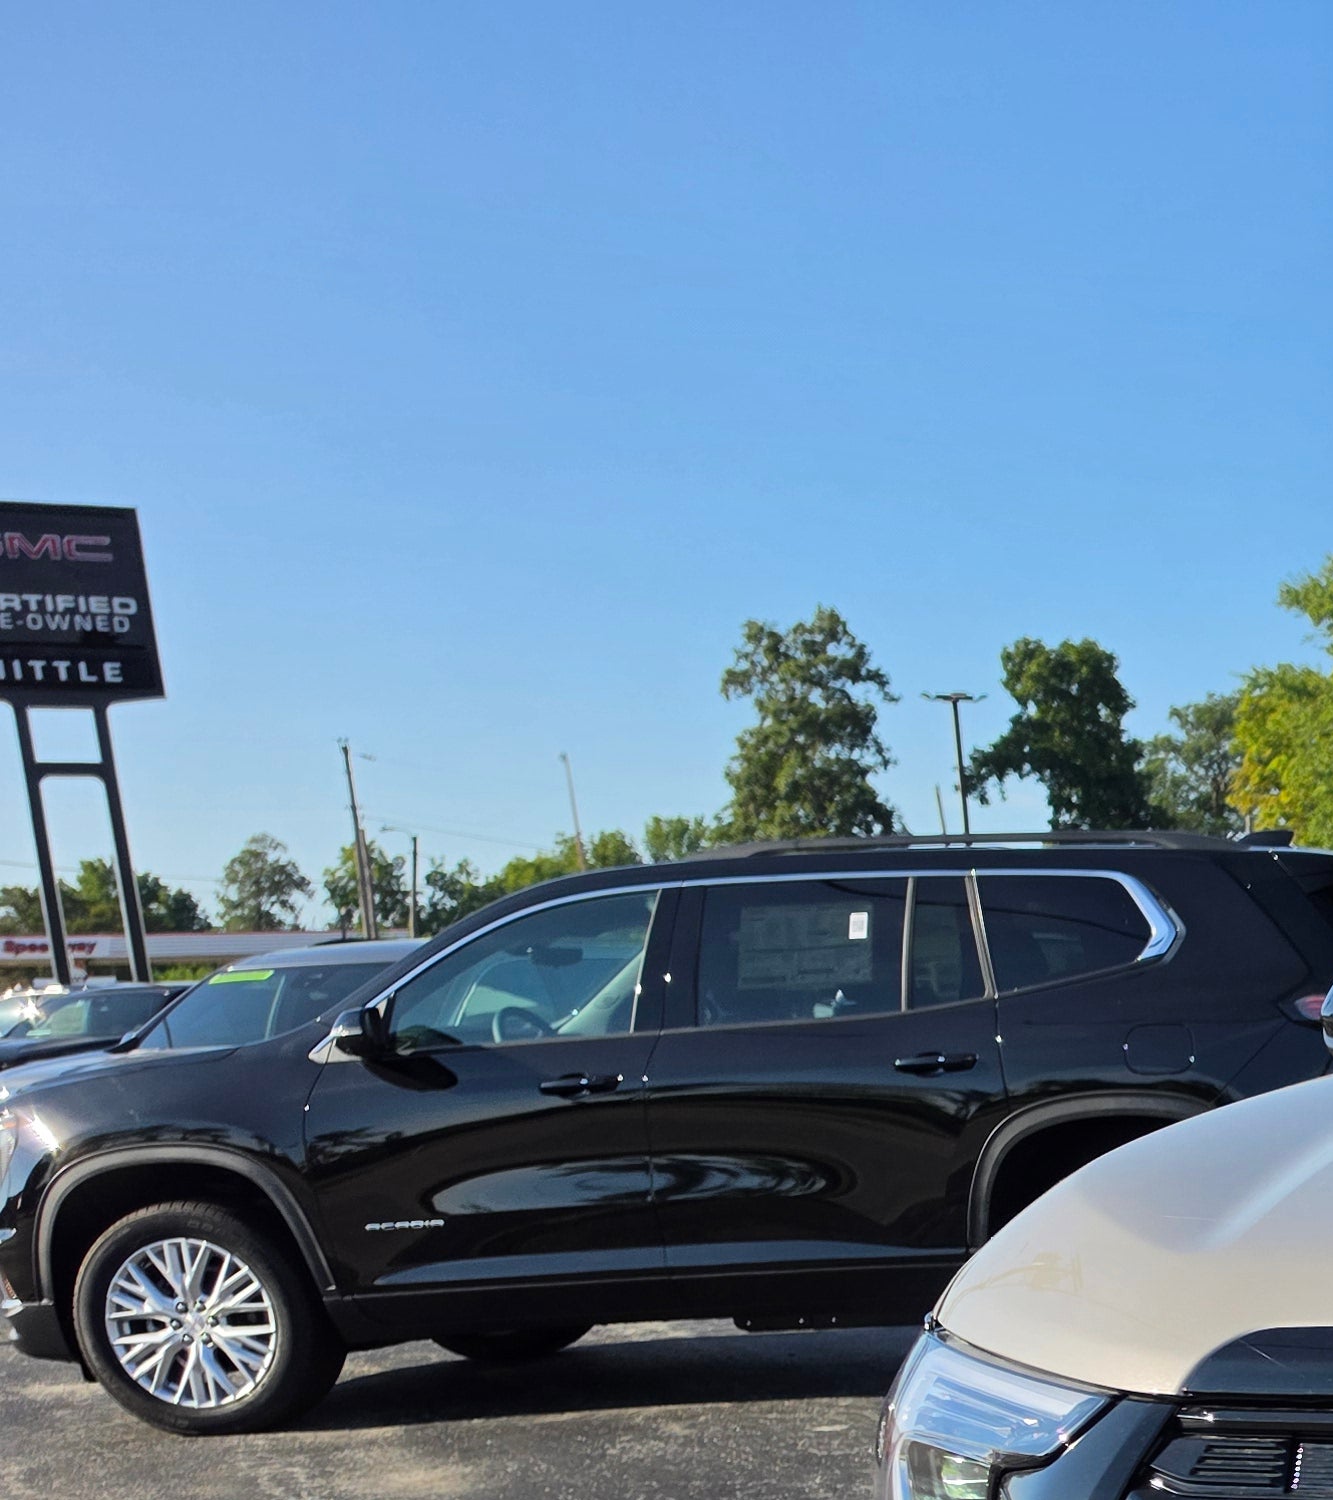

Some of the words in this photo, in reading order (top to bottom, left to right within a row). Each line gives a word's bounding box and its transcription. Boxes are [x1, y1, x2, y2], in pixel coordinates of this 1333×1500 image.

[0, 593, 137, 616] RTIFIED
[0, 612, 130, 633] E-OWNED
[4, 940, 97, 955] Speeay
